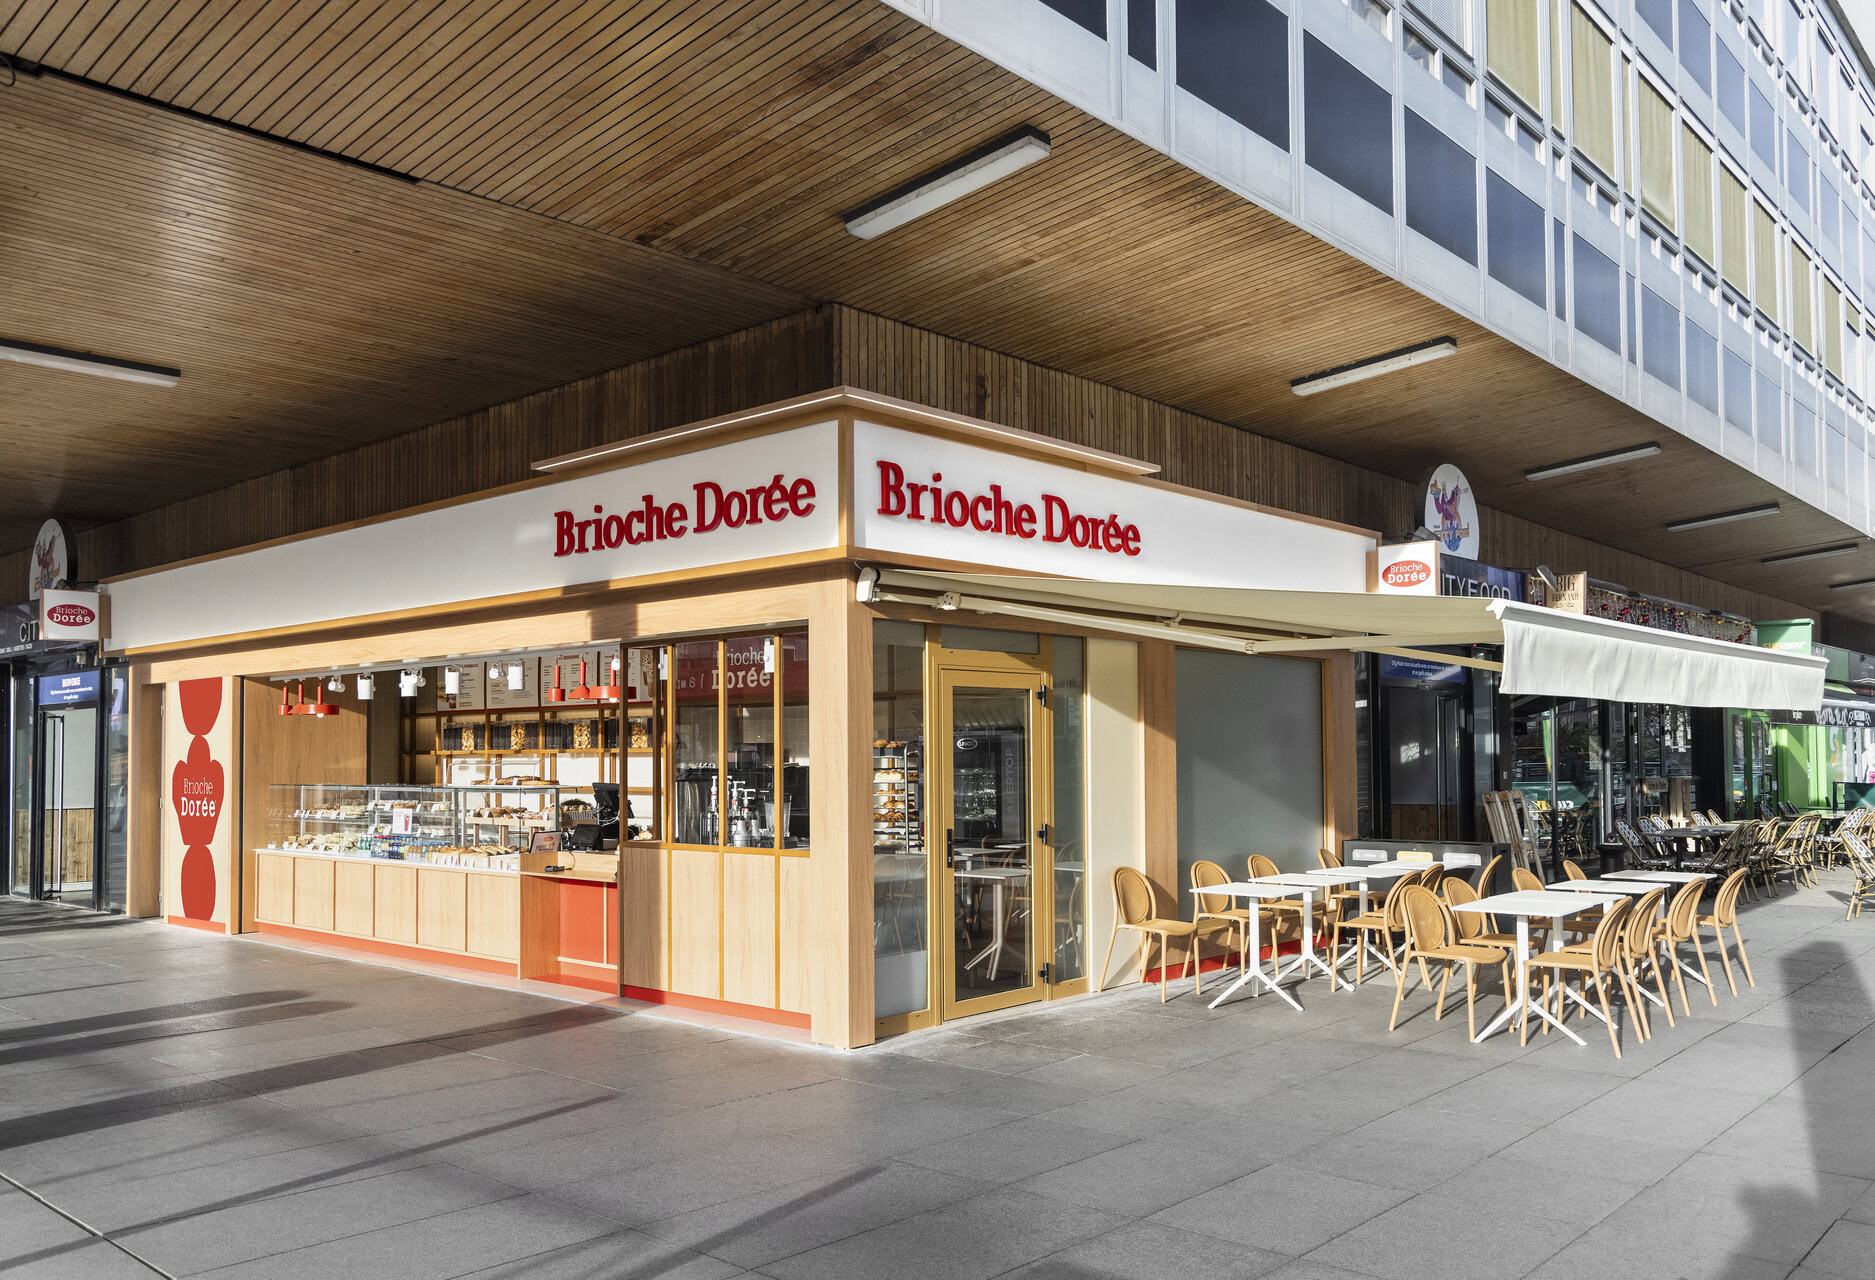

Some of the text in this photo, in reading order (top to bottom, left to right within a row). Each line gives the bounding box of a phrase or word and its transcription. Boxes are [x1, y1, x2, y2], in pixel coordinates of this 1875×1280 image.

[554, 474, 816, 557] Brioche Dorée
[876, 460, 1141, 556] Brioche Dorée
[1390, 563, 1424, 574] Brioche
[1387, 571, 1427, 584] Dorée
[1556, 575, 1576, 592] BIG
[1442, 574, 1512, 601] ITYFOOD
[1551, 593, 1579, 602] FERNAND
[53, 613, 91, 623] Dorée
[55, 606, 89, 615] Brioche
[183, 777, 213, 794] Brioche
[1005, 748, 1014, 824] BAKERTOP
[180, 796, 217, 817] Dorée
